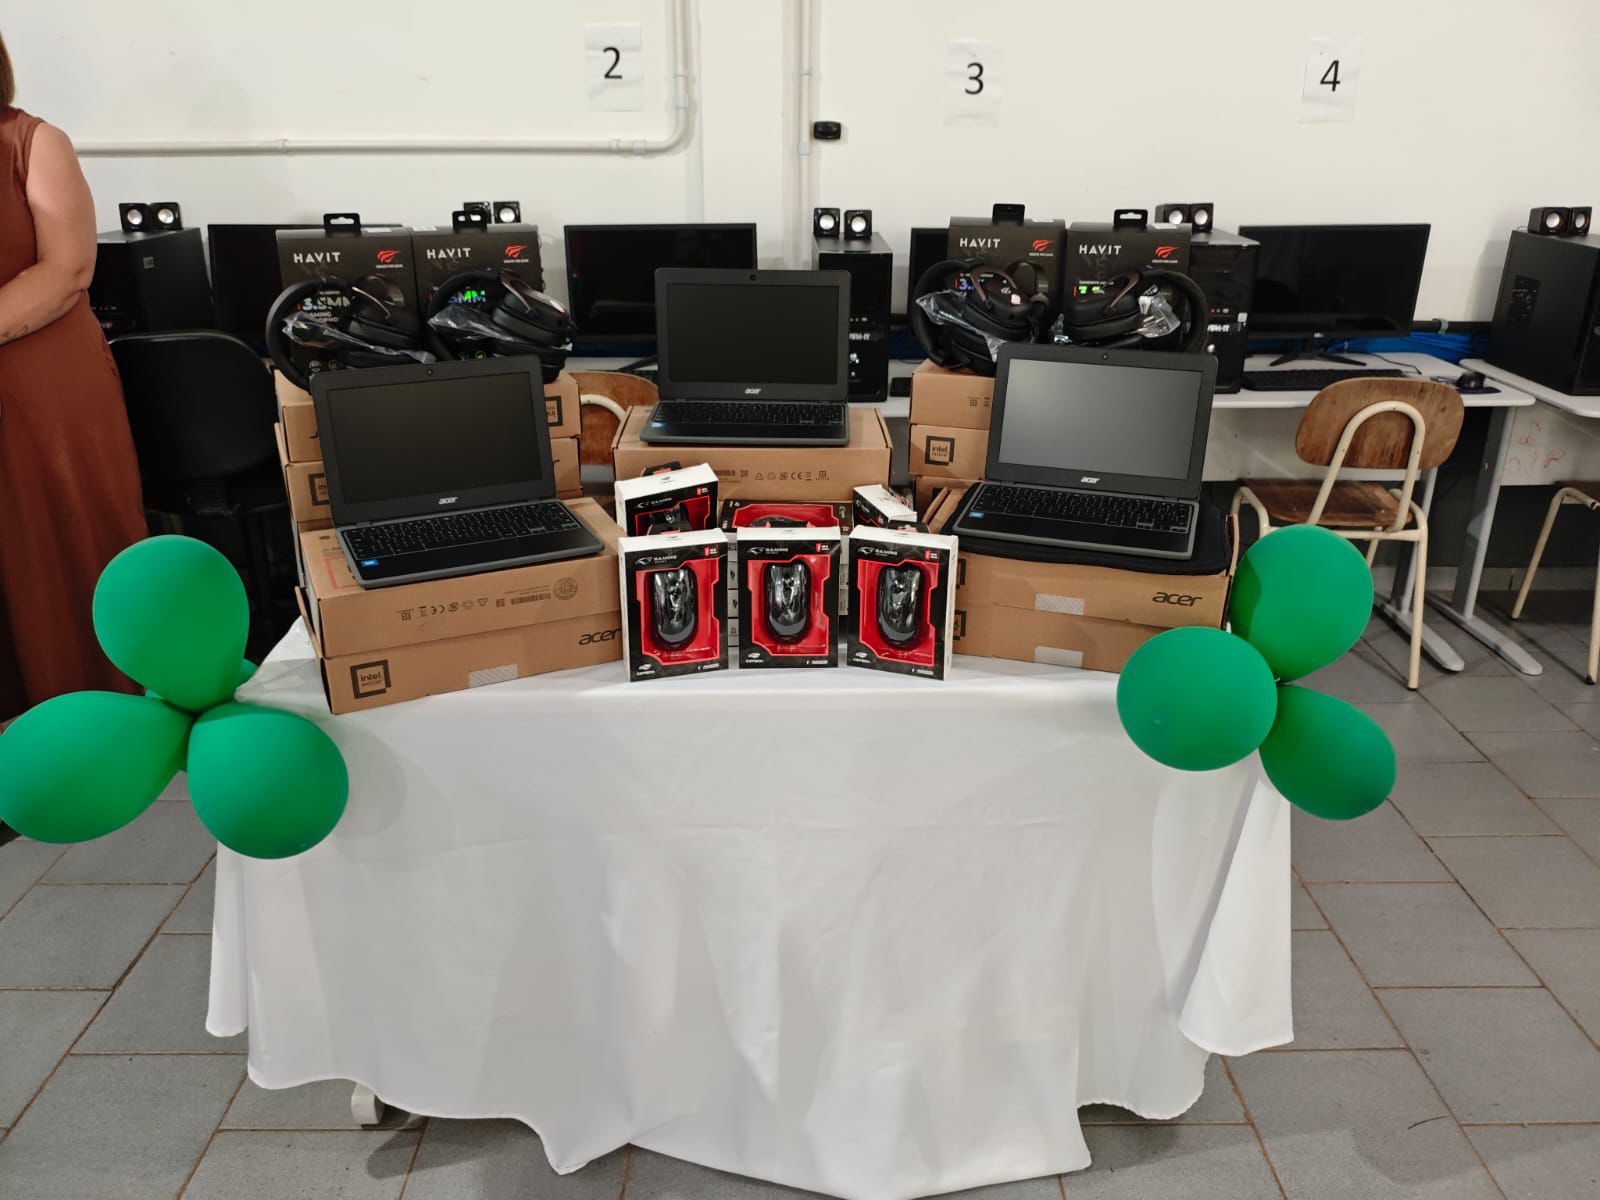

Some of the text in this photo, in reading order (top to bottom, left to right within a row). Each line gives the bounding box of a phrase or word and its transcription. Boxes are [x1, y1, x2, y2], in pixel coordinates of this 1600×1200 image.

[603, 46, 623, 79] 2
[965, 62, 984, 95] 3
[1319, 60, 1341, 92] 4
[959, 237, 1001, 248] HAVIT
[1078, 244, 1122, 255] HAVIT
[293, 252, 341, 264] HAVIT
[426, 248, 471, 260] HAVIT
[1151, 591, 1204, 607] acer
[578, 628, 622, 645] acer
